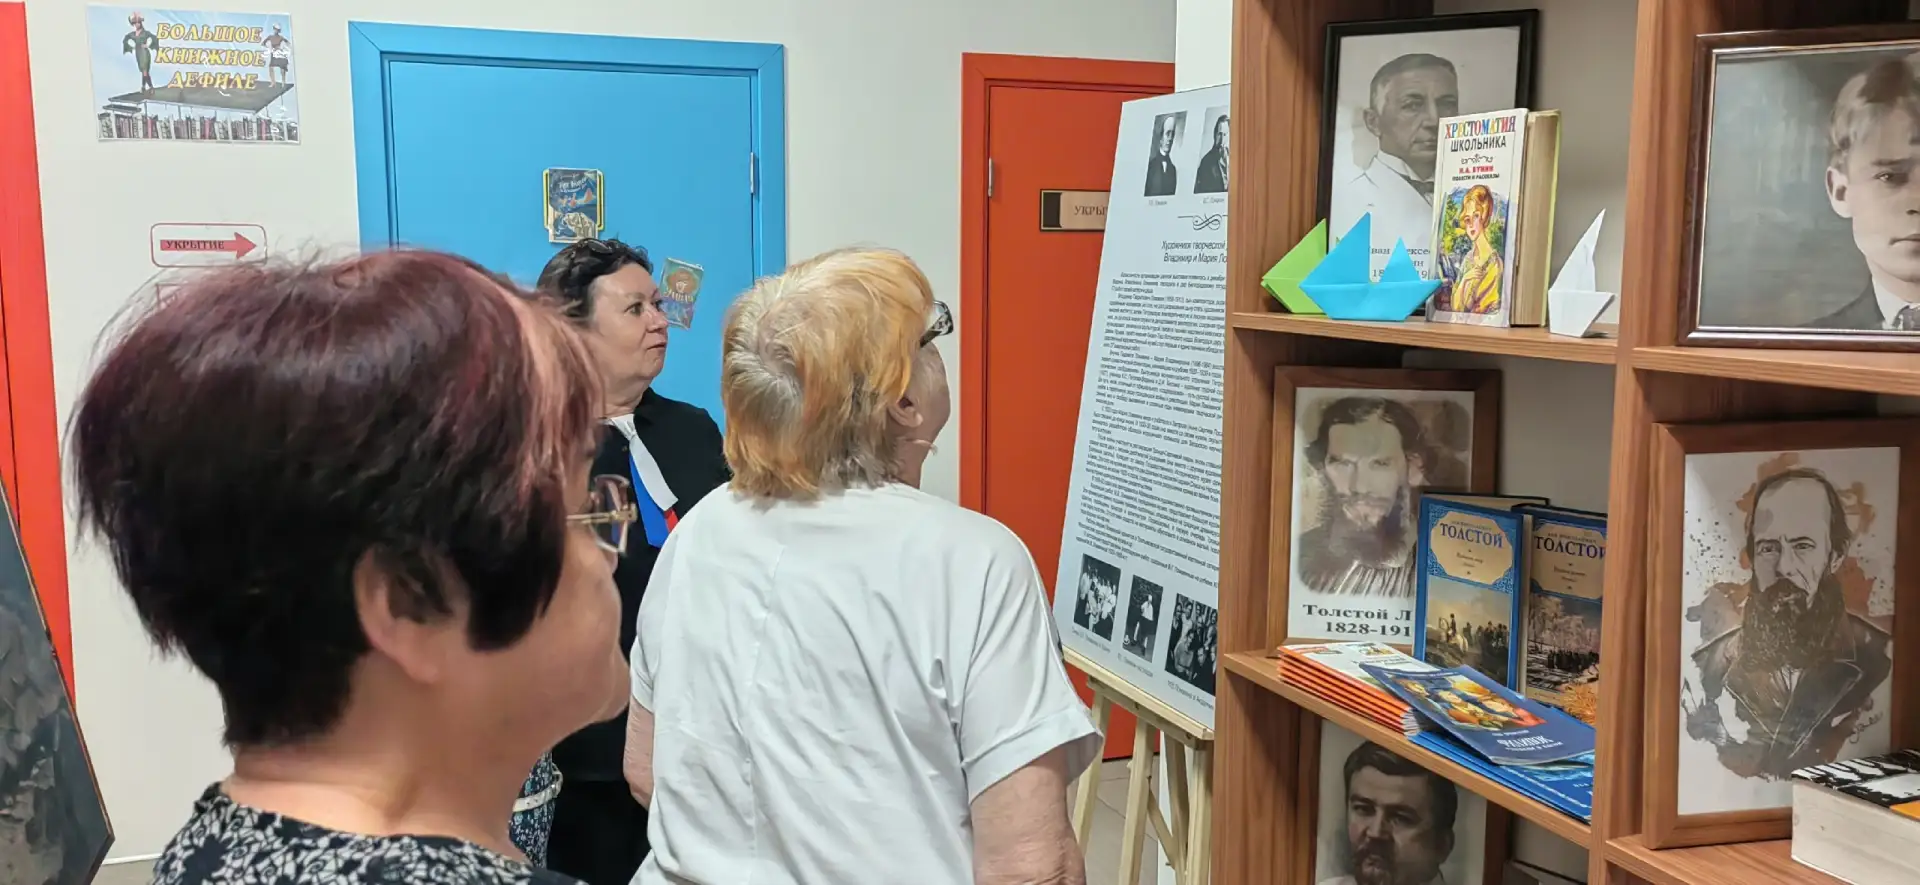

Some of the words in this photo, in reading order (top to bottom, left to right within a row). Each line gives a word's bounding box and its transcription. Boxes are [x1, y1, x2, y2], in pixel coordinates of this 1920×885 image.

[156, 23, 263, 43] БОЛЬШОЕ
[155, 47, 266, 67] КНИЖНОЕ
[167, 71, 259, 90] ДЕФИЛЕ
[1445, 116, 1516, 139] ХРЕСТОМАТИЯ
[1451, 136, 1507, 152] ШКОЛЬНИКА
[165, 240, 225, 250] УКРЫТИЕ
[1440, 523, 1503, 548] ТОЛСТОЙ
[1302, 604, 1389, 620] Толстой
[1326, 621, 1411, 637] 1828-191
